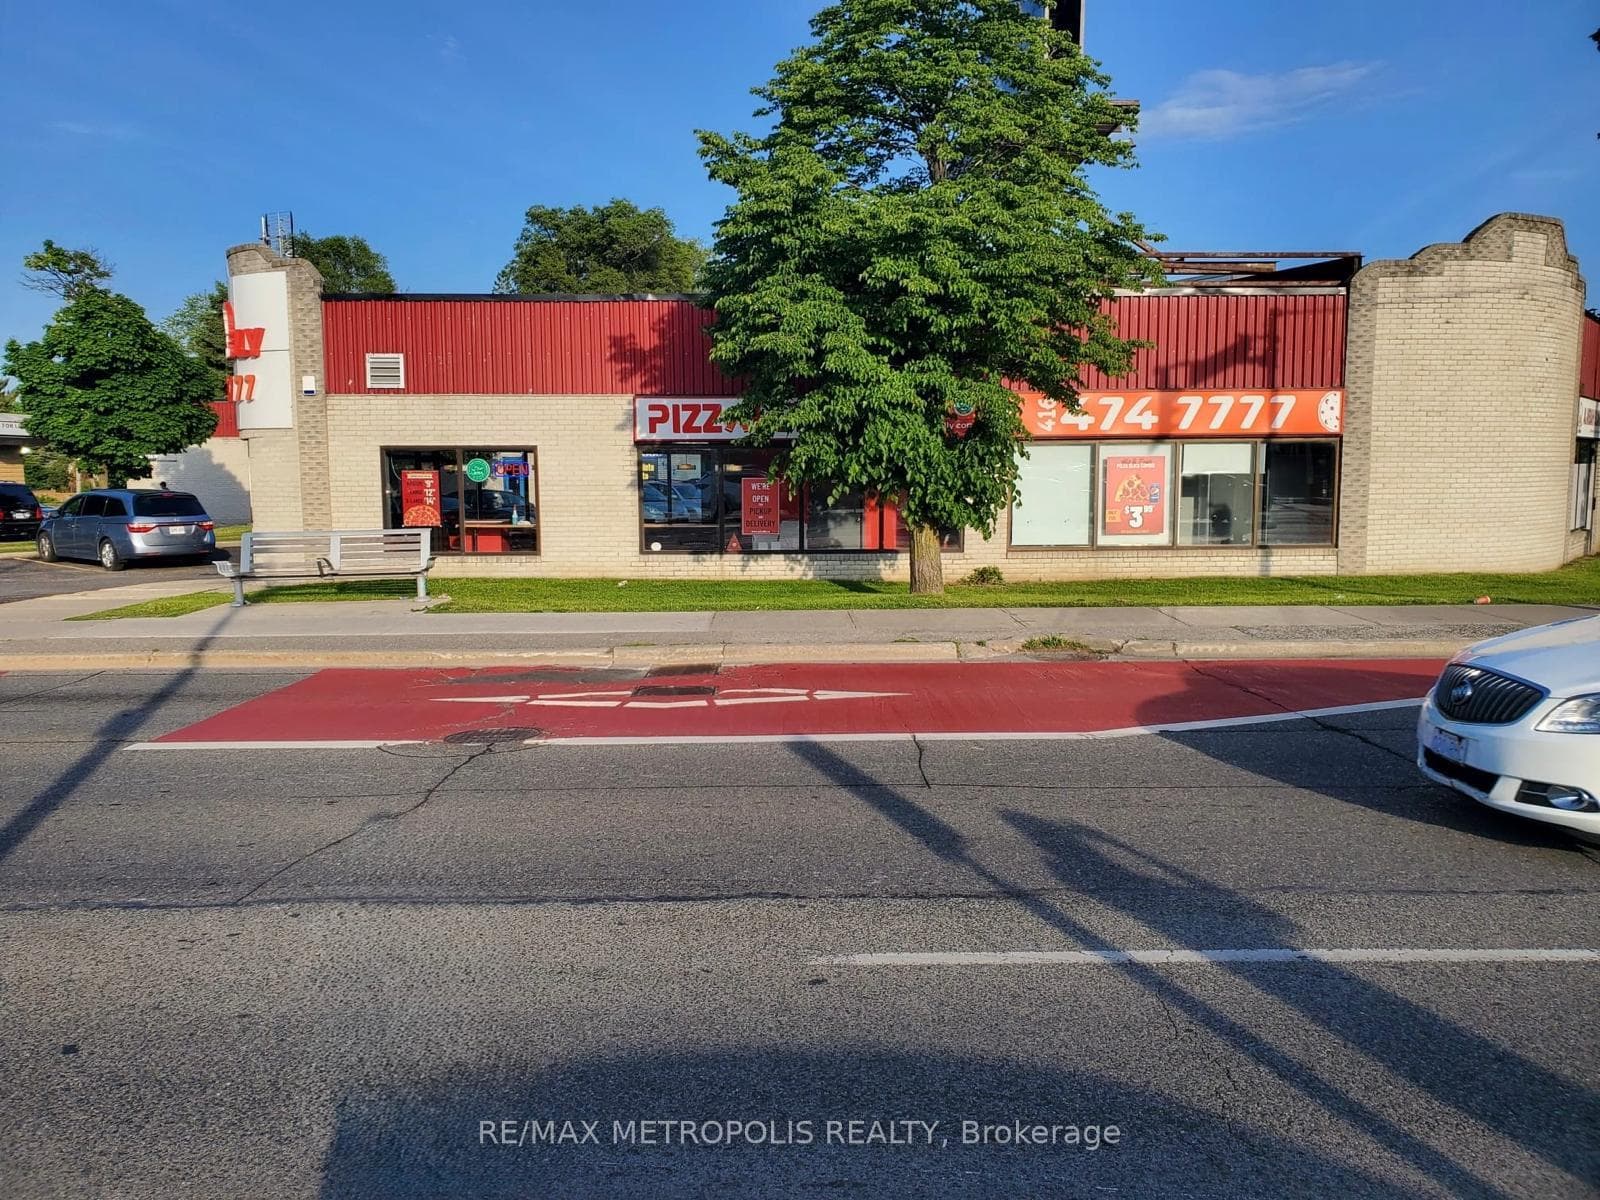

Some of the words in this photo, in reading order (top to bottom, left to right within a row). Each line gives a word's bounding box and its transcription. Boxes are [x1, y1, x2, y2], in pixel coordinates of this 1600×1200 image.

[1177, 395, 1297, 430] 7777
[497, 463, 529, 475] OPEN
[752, 495, 769, 503] OPEN
[745, 520, 776, 528] DELIVERY
